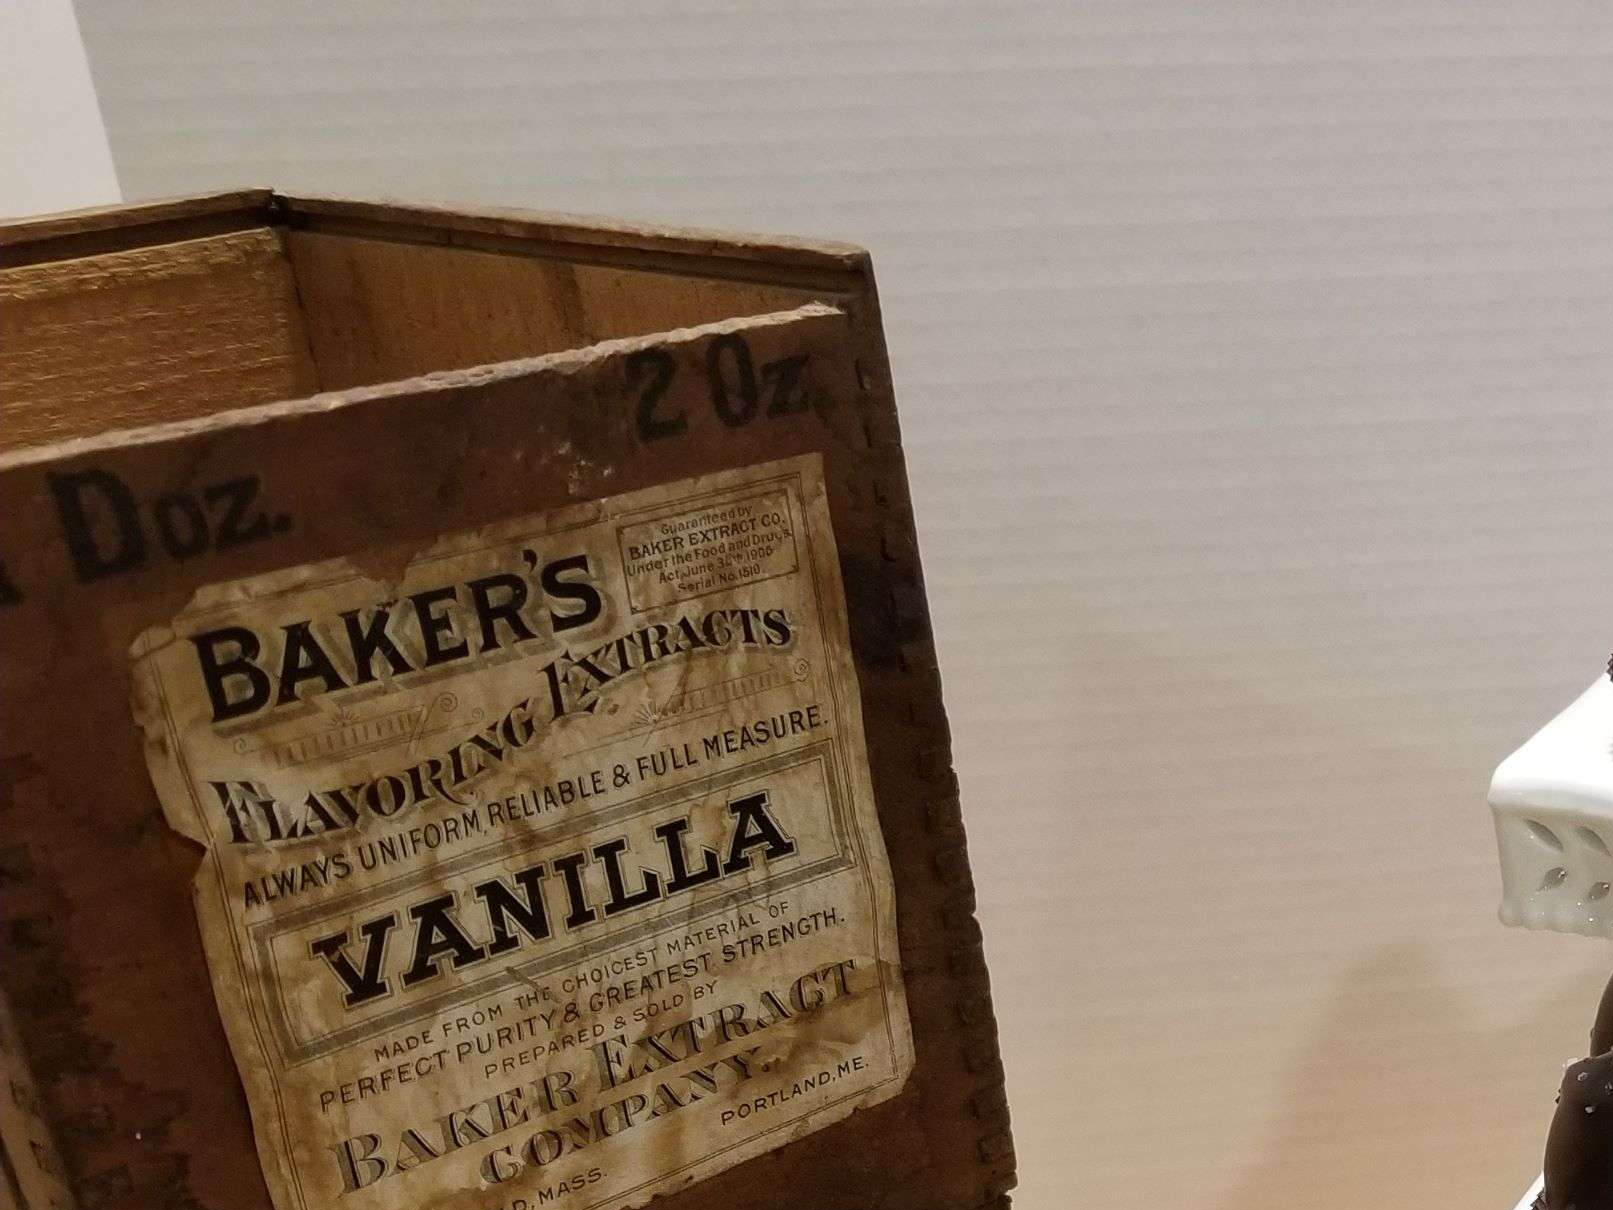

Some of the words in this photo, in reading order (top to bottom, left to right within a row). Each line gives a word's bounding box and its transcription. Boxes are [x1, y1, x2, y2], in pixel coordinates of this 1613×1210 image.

[625, 346, 689, 444] 2
[45, 469, 293, 584] Doz.
[626, 558, 672, 577] Under
[672, 552, 693, 566] the
[695, 543, 726, 560] Food
[728, 535, 750, 551] and
[628, 535, 685, 561] BAKER
[688, 517, 757, 546] EXTRACT
[760, 511, 786, 528] CO.
[660, 508, 735, 536] Guaranteed
[678, 575, 716, 593] Serial
[188, 549, 604, 725] BAKER'S
[208, 697, 536, 845] FLAVORING
[540, 608, 794, 719] EXTRACTS
[242, 853, 352, 909] ALWAYS
[358, 809, 489, 871] UNIFORM,
[486, 770, 606, 829] RELIABLE
[612, 763, 632, 790] &
[635, 748, 699, 782] FULL
[702, 704, 830, 762] MEASURE.
[309, 790, 800, 1008] VANILLA
[319, 1049, 448, 1116] PERFECT
[456, 1008, 558, 1064] PURITY
[563, 1001, 581, 1023] &
[588, 952, 712, 1014] GREATEST
[722, 906, 846, 963] STRENGTH.
[373, 1032, 435, 1063] MADE
[441, 1004, 504, 1038] FROM
[513, 986, 552, 1010] THE
[561, 947, 656, 994] CHOICEST
[666, 912, 760, 956] MATERIAL
[767, 900, 790, 919] OF
[483, 1022, 606, 1080] PREPARED
[613, 1014, 629, 1031] &
[632, 992, 685, 1024] SOLD
[693, 979, 719, 1000] BY
[329, 1069, 582, 1194] BAKER
[591, 958, 858, 1090] EXTRACT
[481, 1045, 773, 1186] COMPANY.
[538, 1166, 609, 1206] MASS.
